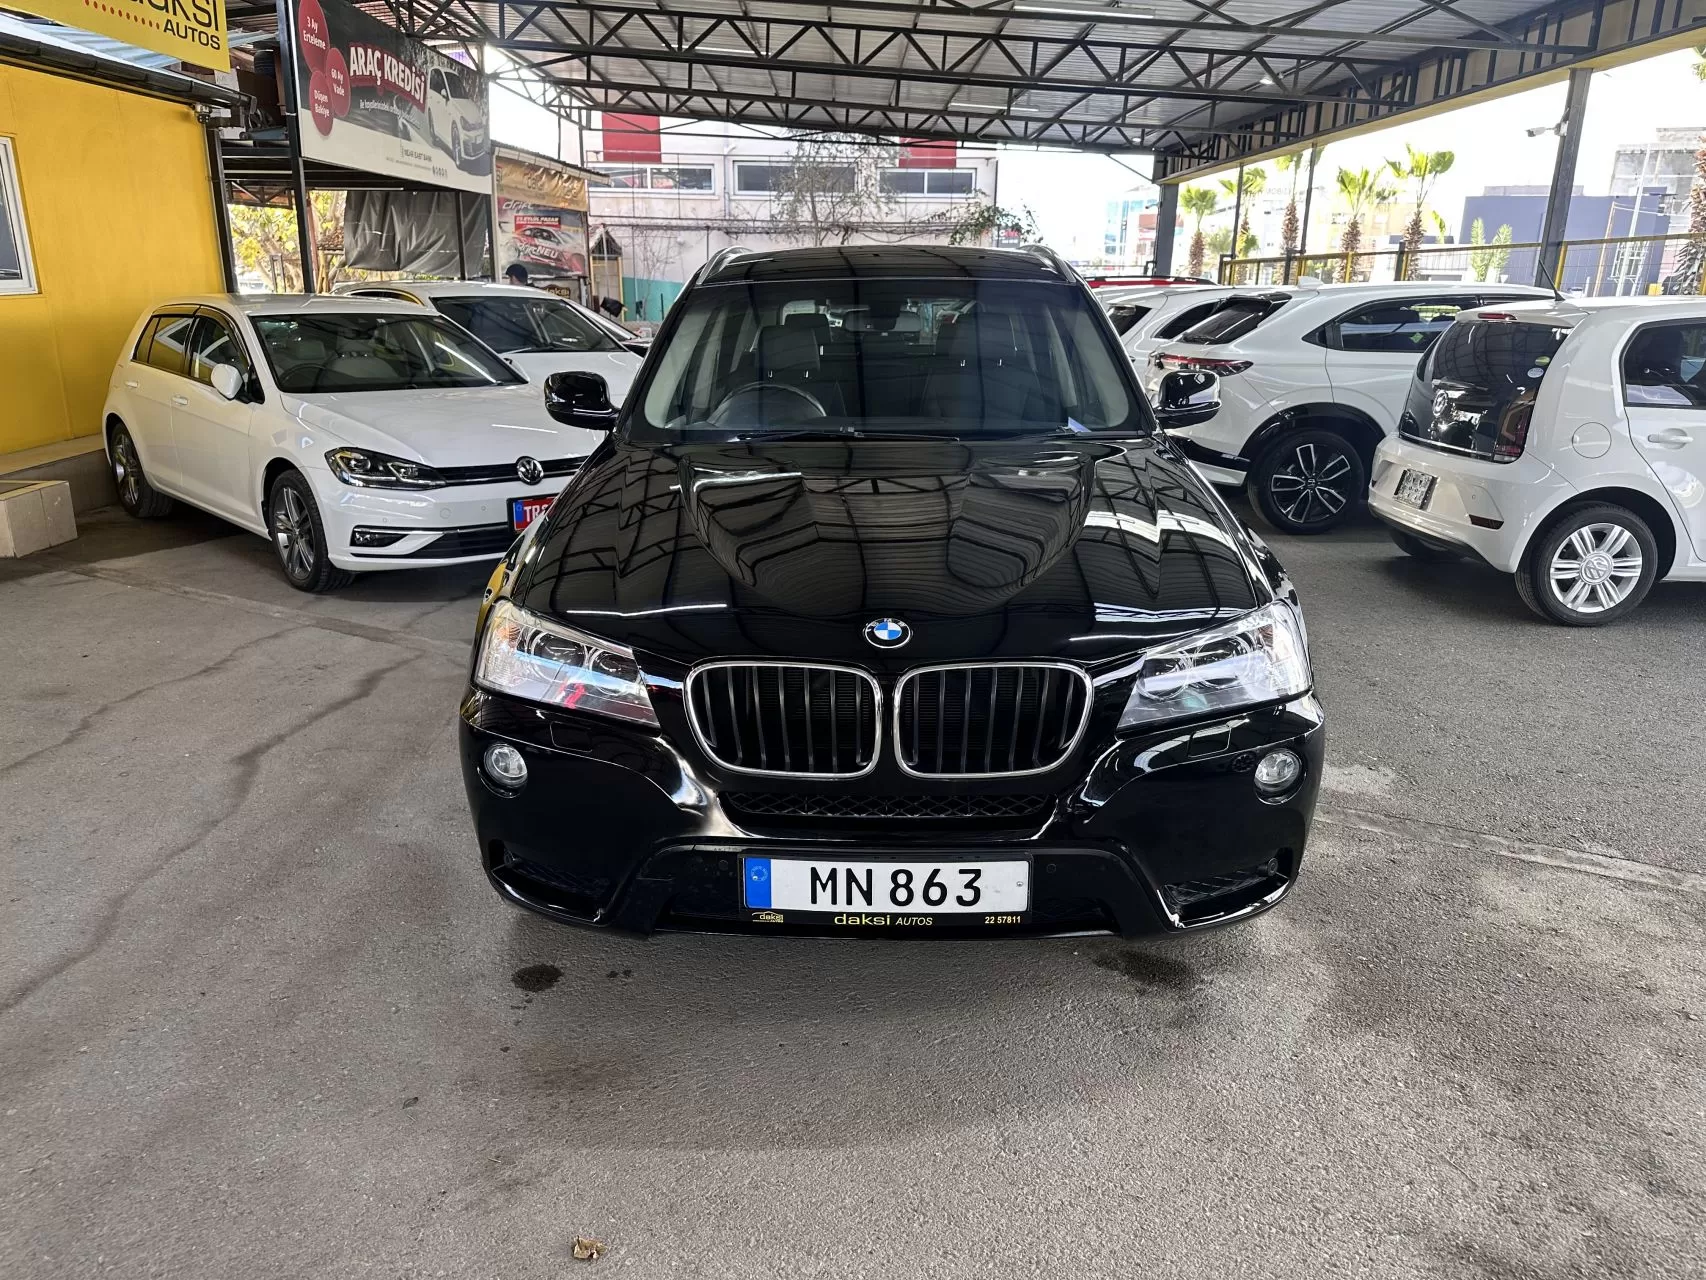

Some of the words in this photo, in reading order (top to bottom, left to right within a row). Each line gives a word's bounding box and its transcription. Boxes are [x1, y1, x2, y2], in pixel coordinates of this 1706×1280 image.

[306, 17, 312, 27] 3
[311, 19, 318, 33] Ay
[163, 18, 221, 50] AUTOS
[303, 30, 326, 49] Erteleme
[337, 72, 344, 84] Ay
[349, 46, 382, 85] ARAÇ
[383, 53, 425, 104] KREDİSİ
[313, 89, 329, 104] Düşen
[332, 83, 345, 97] Vade
[314, 103, 330, 118] Bakiye
[810, 866, 873, 906] MN
[889, 868, 982, 907] 863
[834, 913, 891, 926] daksi
[895, 916, 933, 926] AUTOS
[984, 916, 995, 924] 22
[996, 915, 1021, 924] 57811
